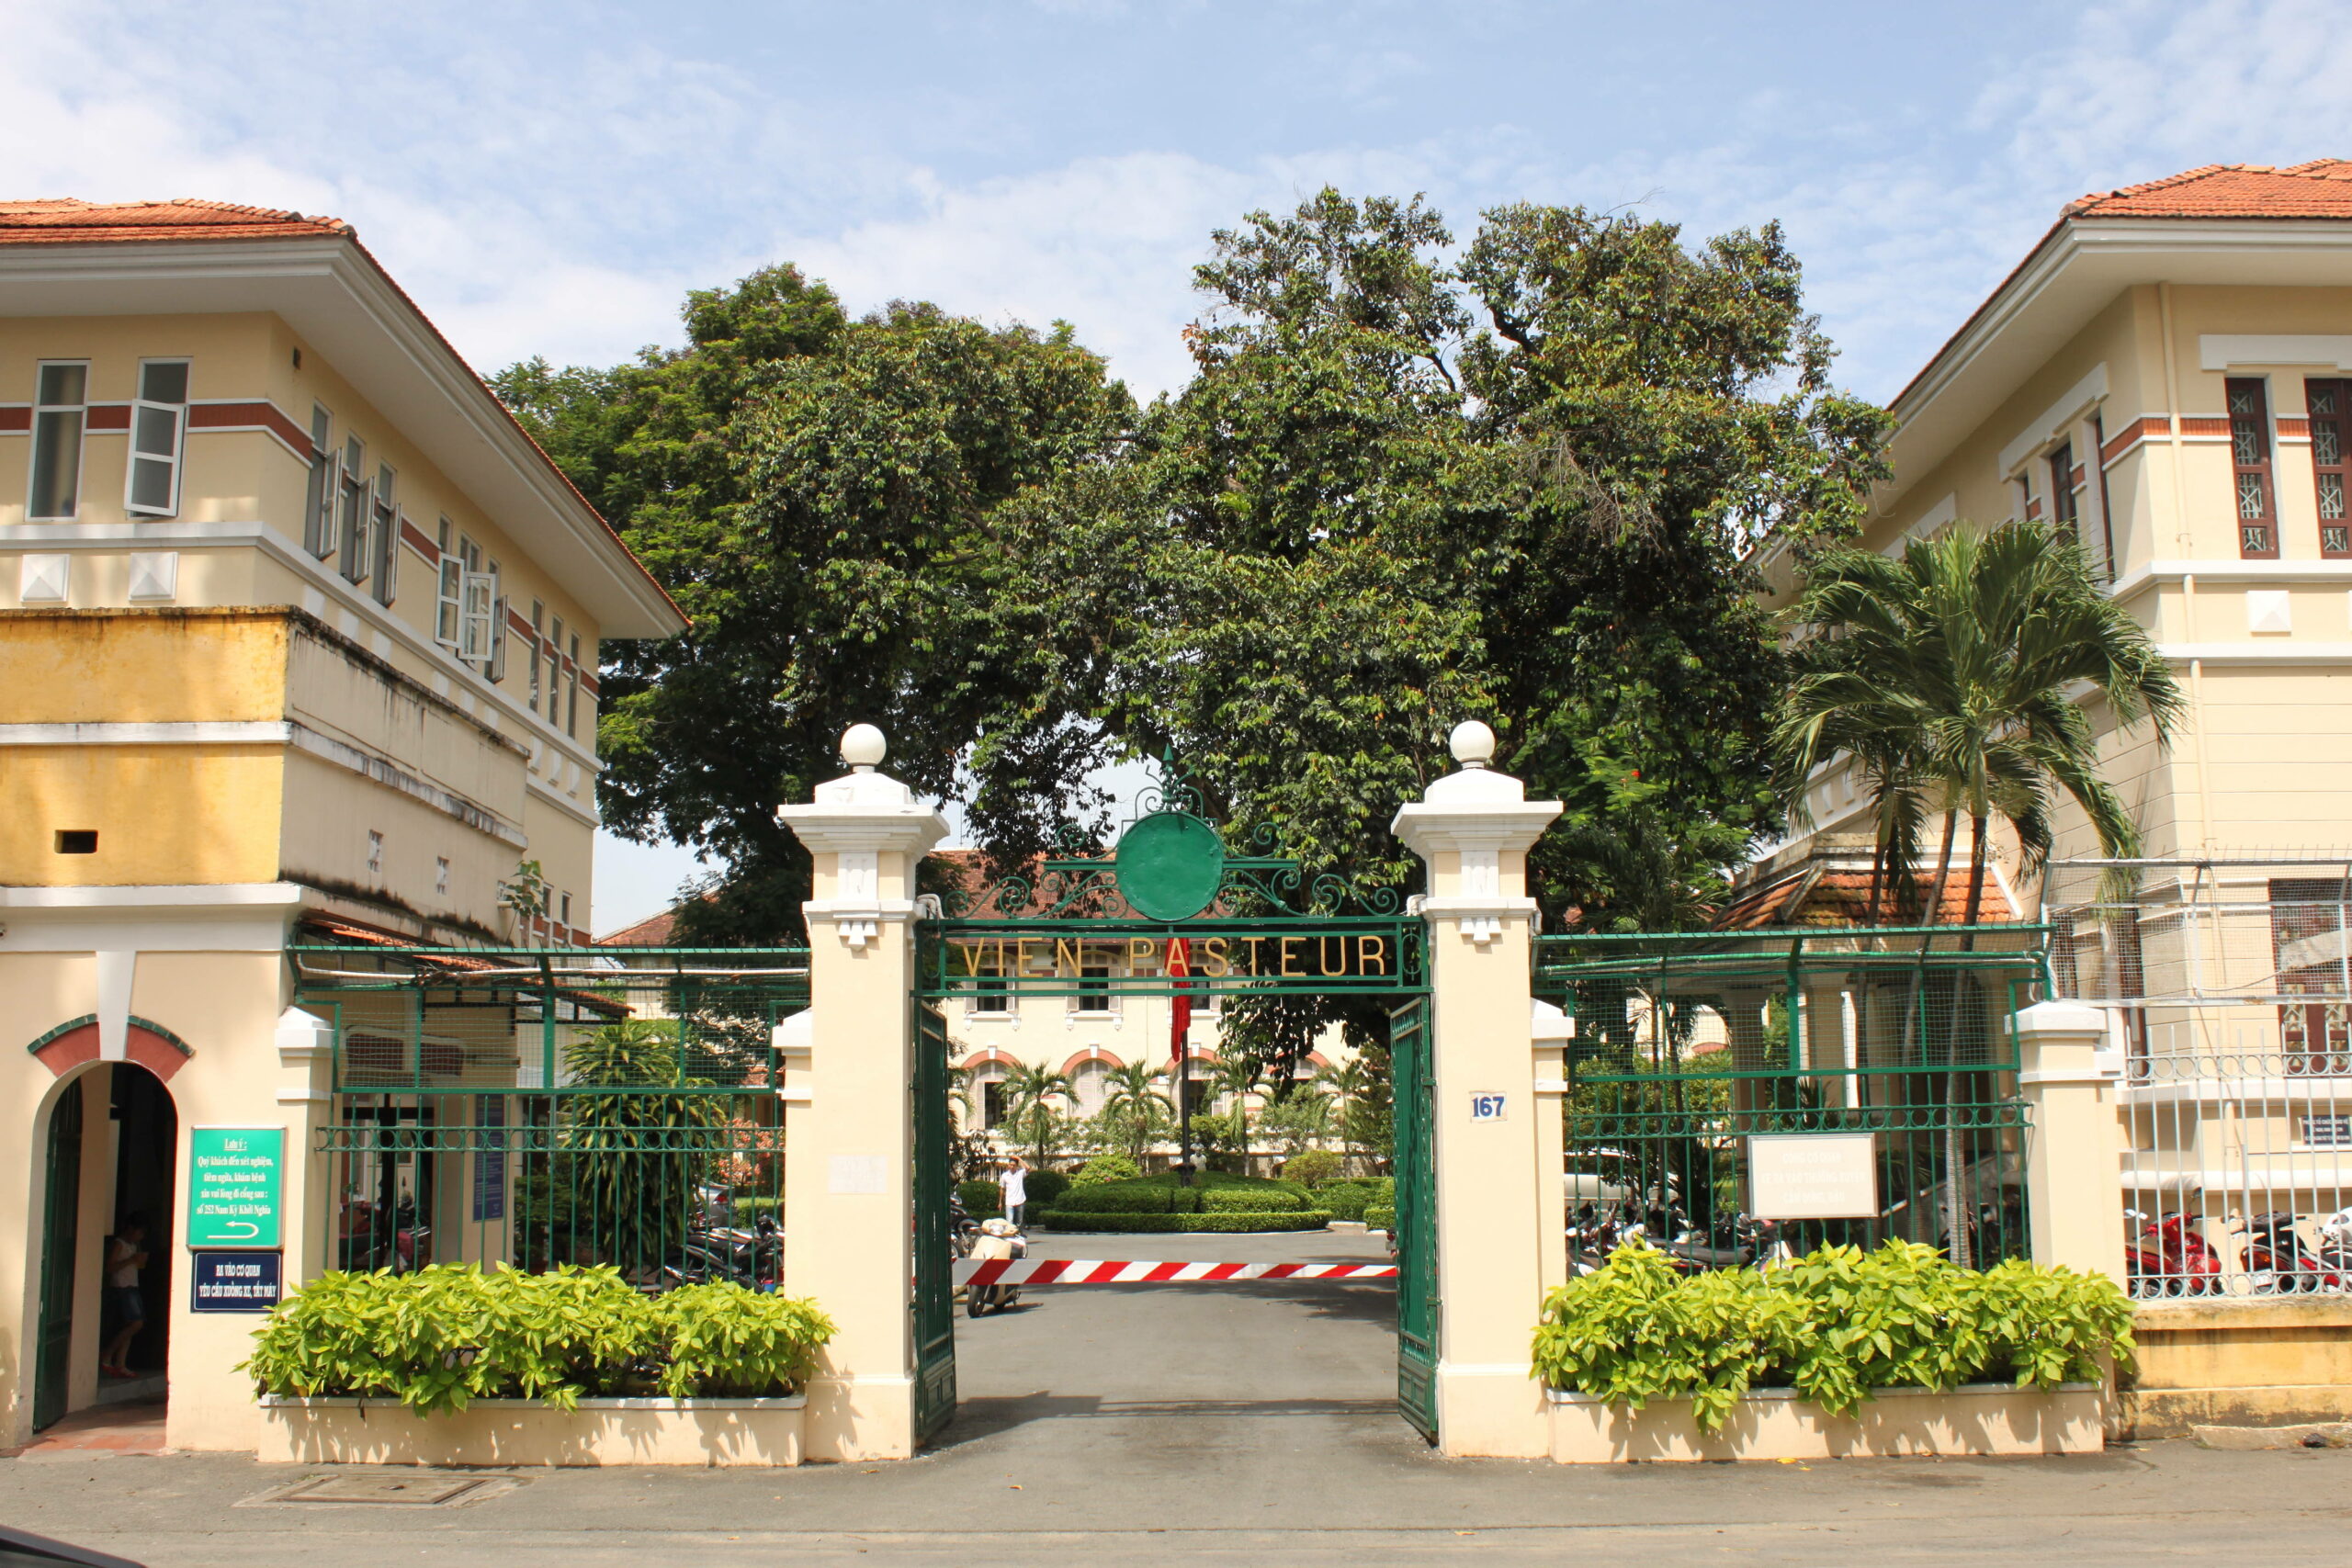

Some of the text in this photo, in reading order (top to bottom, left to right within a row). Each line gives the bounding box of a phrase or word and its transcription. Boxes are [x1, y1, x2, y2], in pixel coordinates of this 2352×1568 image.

[963, 935, 1385, 977] VIEN PASTEUR
[1472, 1096, 1505, 1117] 167
[224, 1138, 238, 1149] Lưu
[198, 1156, 209, 1168] Quý
[210, 1156, 228, 1166] khách
[228, 1155, 240, 1166] đến
[240, 1156, 250, 1166] xét
[204, 1172, 218, 1182] tiêm
[234, 1172, 251, 1182] khám
[251, 1172, 266, 1183] bệnh
[200, 1188, 210, 1198] xin
[210, 1188, 220, 1198] vui
[220, 1188, 233, 1200] lòng
[233, 1188, 240, 1198] đi
[240, 1186, 254, 1200] cổng
[197, 1203, 271, 1216] số 252 Nam Kỳ Khởi Nghĩa
[216, 1261, 261, 1277] RA VÀO CƠ QUAN
[199, 1281, 210, 1297] YÊU
[253, 1280, 264, 1297] TẮT
[264, 1281, 277, 1297] MÁY
